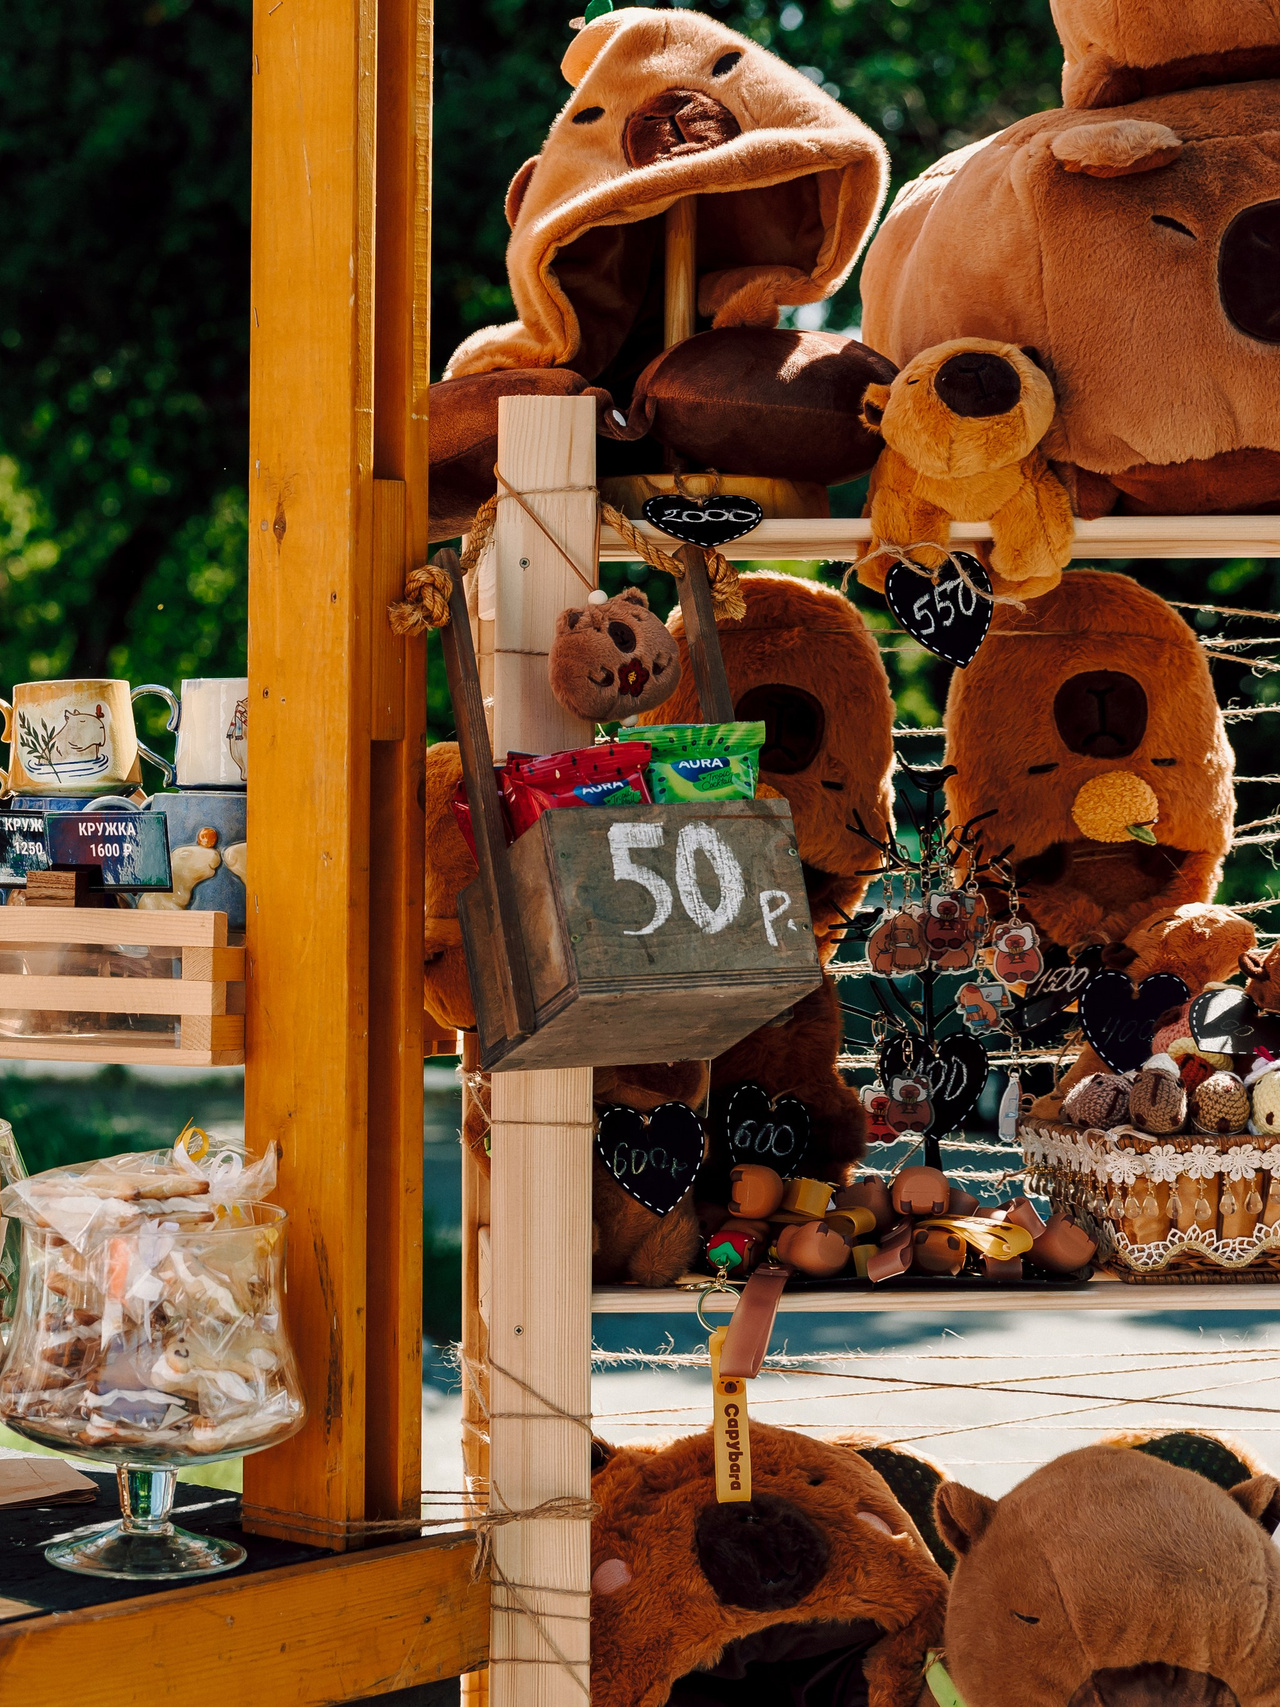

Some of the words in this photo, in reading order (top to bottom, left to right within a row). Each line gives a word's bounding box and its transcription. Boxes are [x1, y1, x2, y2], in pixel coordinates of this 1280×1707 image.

[661, 508, 757, 523] 2000
[913, 576, 977, 635] 550
[678, 757, 723, 768] AURA
[706, 771, 731, 782] Tropic
[582, 781, 624, 795] AURA
[4, 817, 44, 832] КРУЖ
[78, 822, 137, 837] КРУЖКА
[14, 841, 44, 855] 1250
[89, 843, 120, 857] 1600
[607, 821, 745, 935] 50
[734, 1119, 795, 1156] 600
[723, 1403, 744, 1491] Capybara
